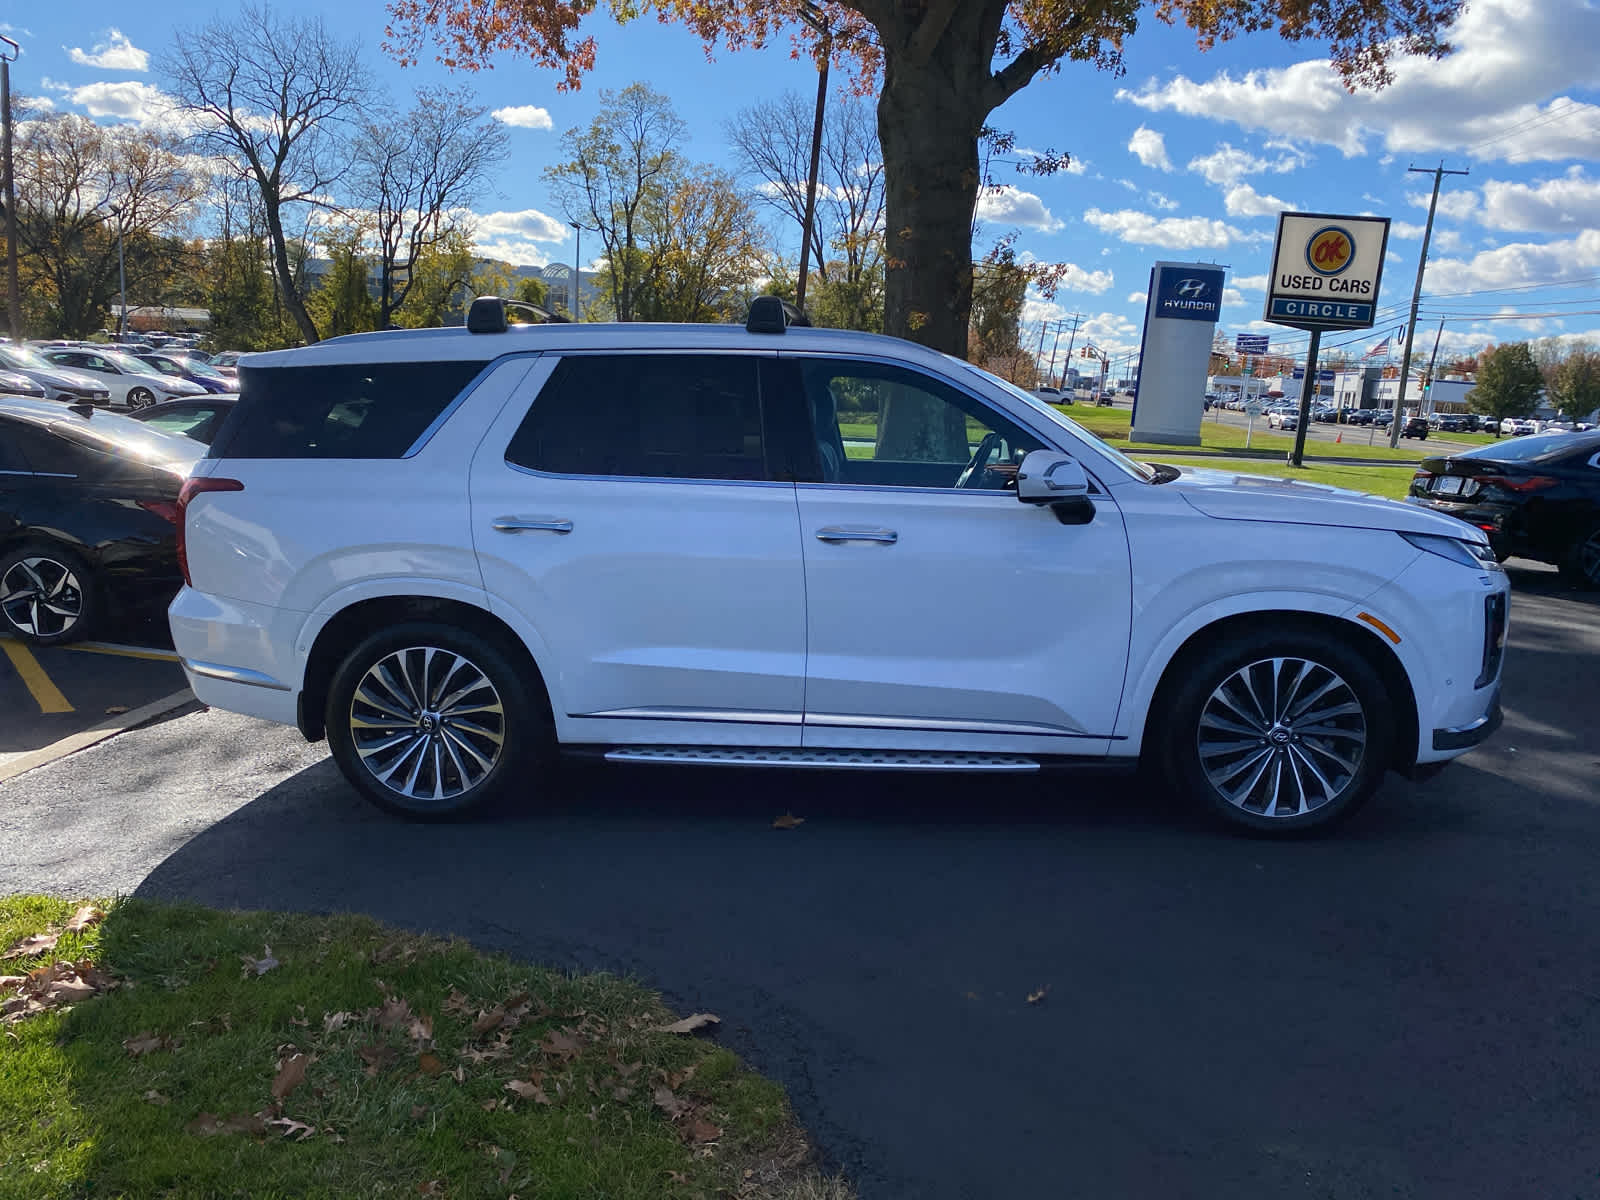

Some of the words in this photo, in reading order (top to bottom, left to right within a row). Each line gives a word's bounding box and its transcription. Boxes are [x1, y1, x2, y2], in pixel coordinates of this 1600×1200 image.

[1314, 235, 1346, 263] OK
[1281, 274, 1323, 290] USED
[1328, 277, 1372, 294] CARS
[1164, 299, 1216, 311] HYUNDAI
[1286, 302, 1359, 318] CIRCLE
